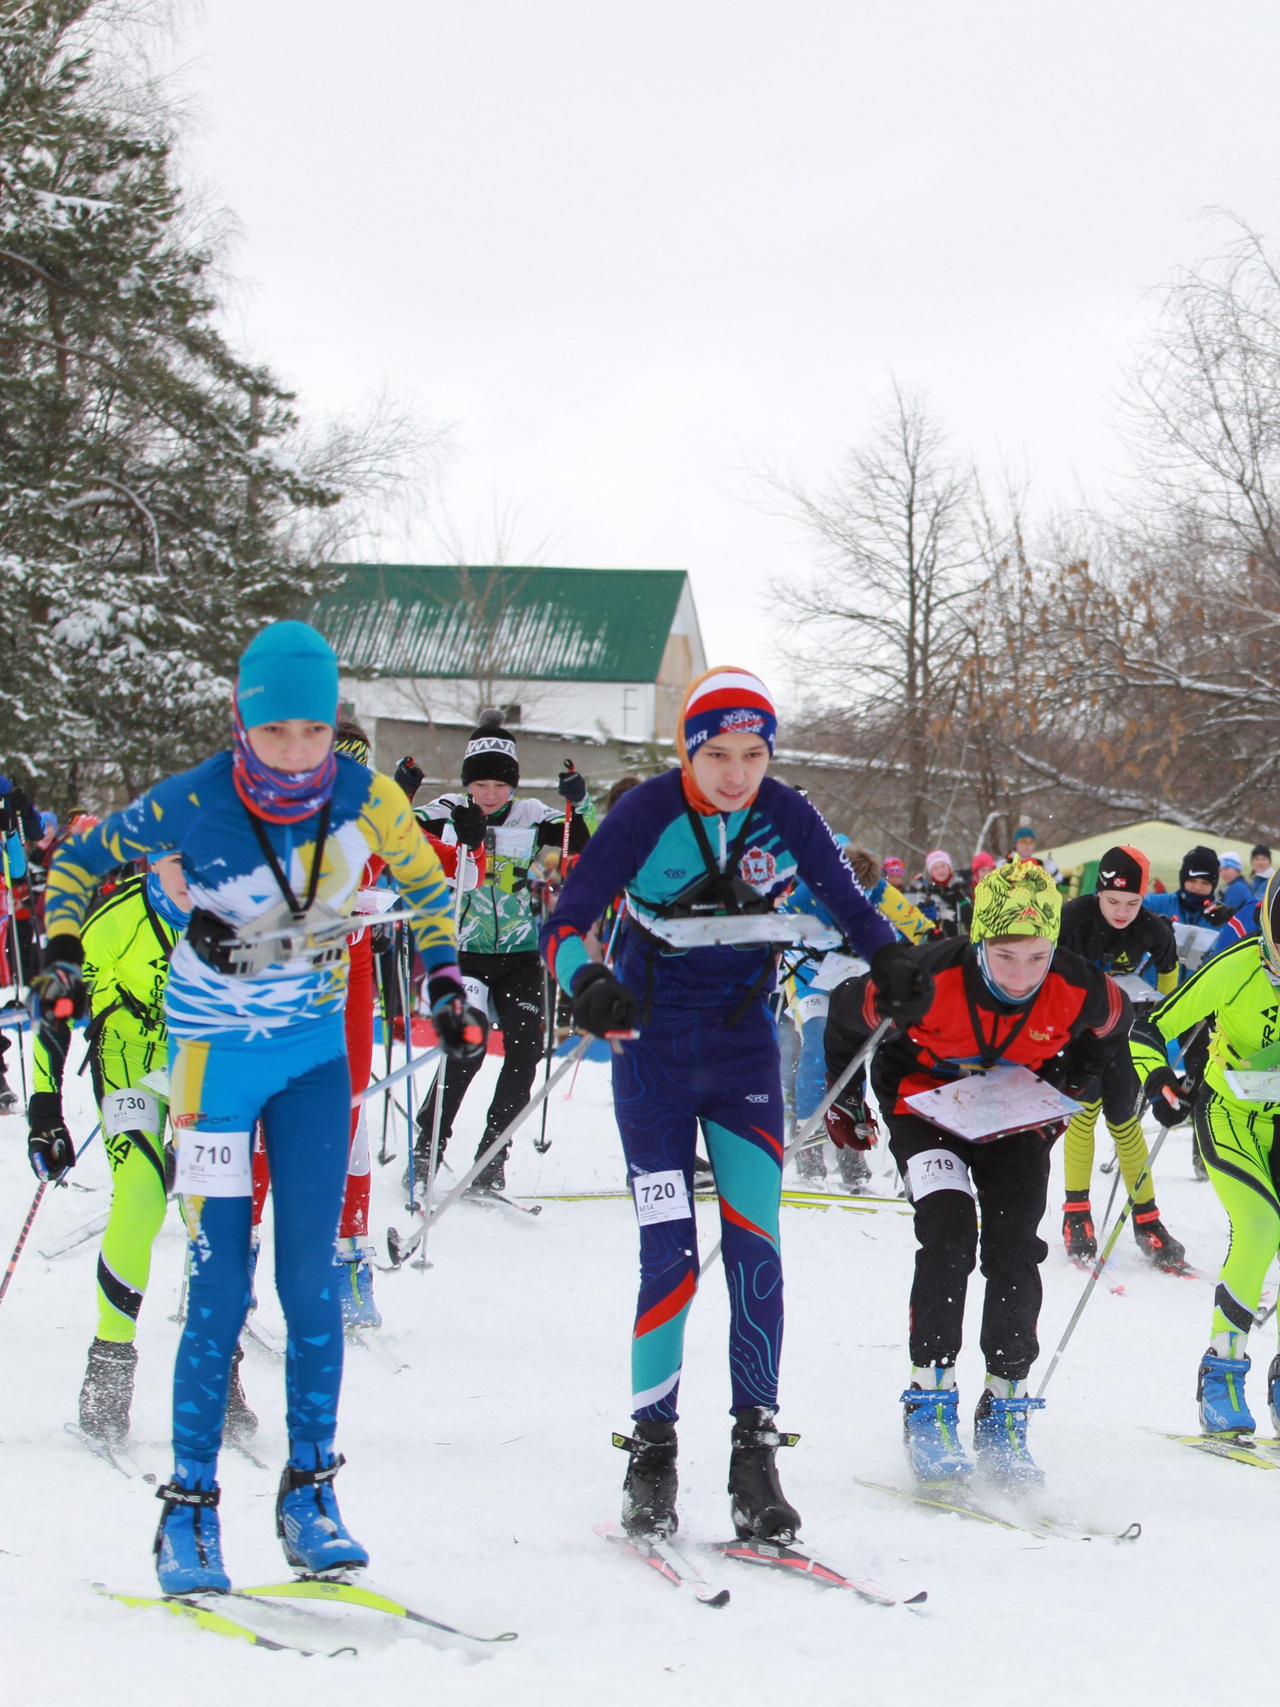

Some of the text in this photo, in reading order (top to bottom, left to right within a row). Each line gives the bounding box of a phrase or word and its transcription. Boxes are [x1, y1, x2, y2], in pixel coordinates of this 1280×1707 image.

[116, 1097, 146, 1111] 730
[195, 1145, 231, 1165] 710
[923, 1158, 954, 1173] 719
[641, 1182, 676, 1203] 720
[164, 1489, 202, 1503] SPINE
